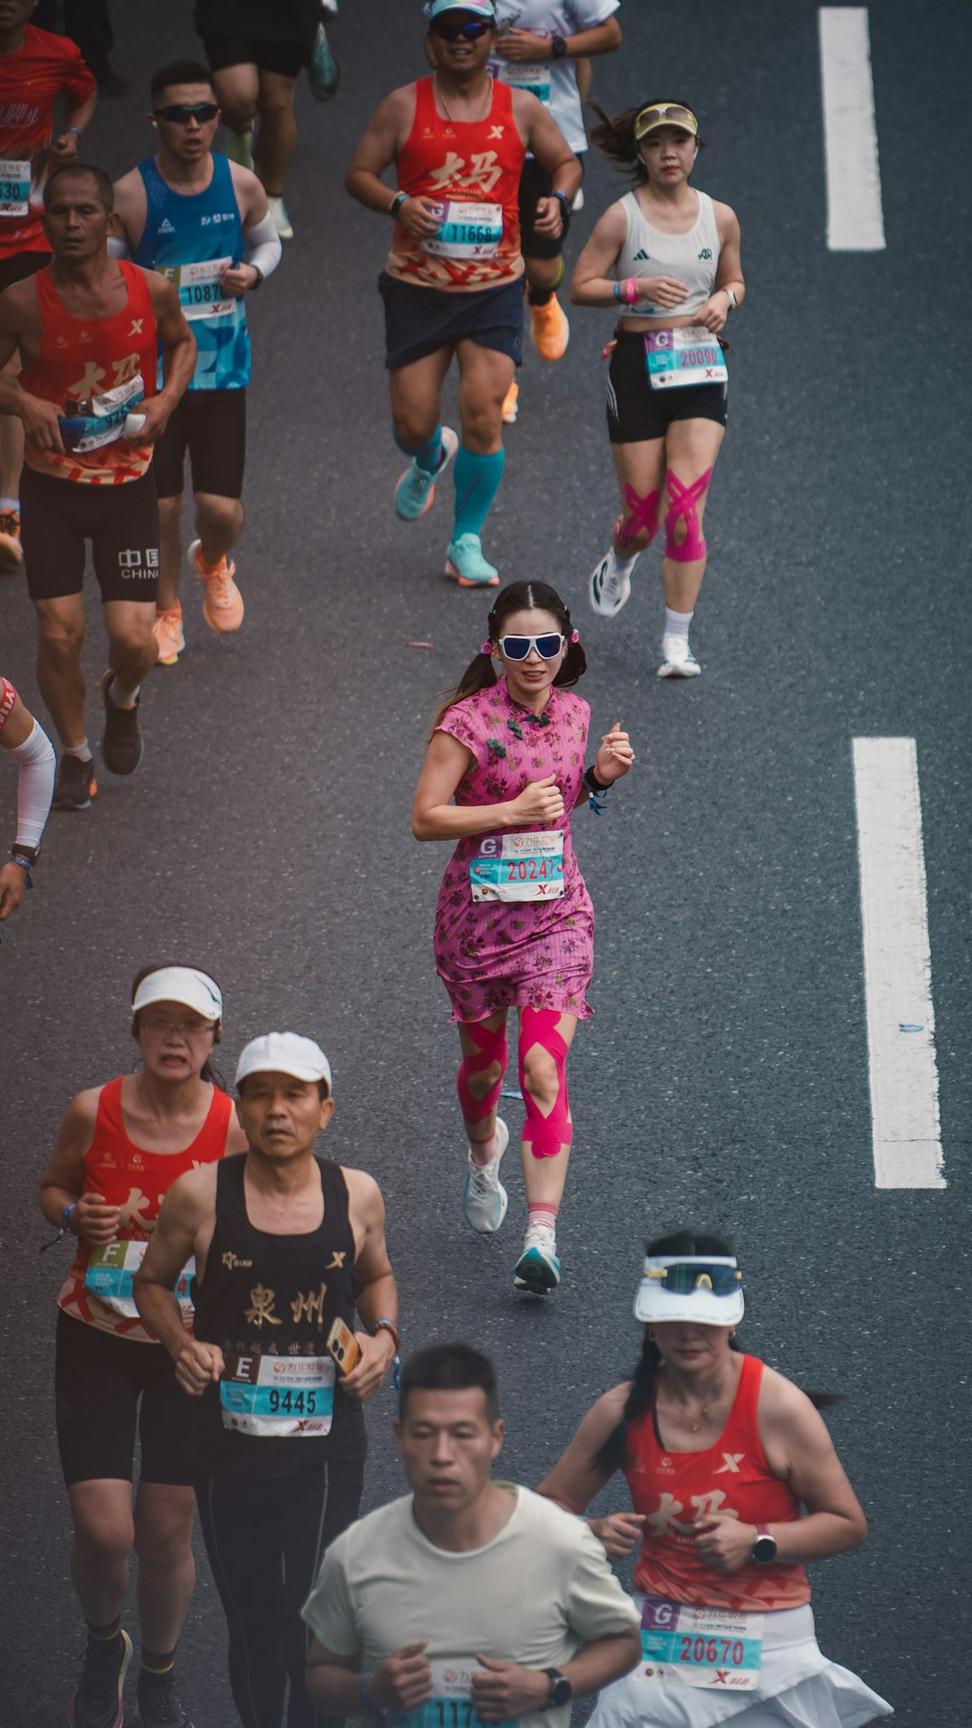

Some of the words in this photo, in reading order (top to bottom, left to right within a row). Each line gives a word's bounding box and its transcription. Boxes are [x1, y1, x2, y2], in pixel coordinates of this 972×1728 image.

[452, 224, 493, 242] 11668
[185, 284, 224, 304] 1087
[655, 331, 669, 347] G
[680, 348, 717, 368] 20090
[118, 549, 159, 568] 中国
[480, 838, 497, 854] G
[102, 1244, 121, 1262] F
[244, 1282, 328, 1330] 泉州
[236, 1357, 253, 1378] E
[269, 1389, 316, 1414] 9445
[654, 1603, 673, 1625] G
[680, 1636, 745, 1665] 20670
